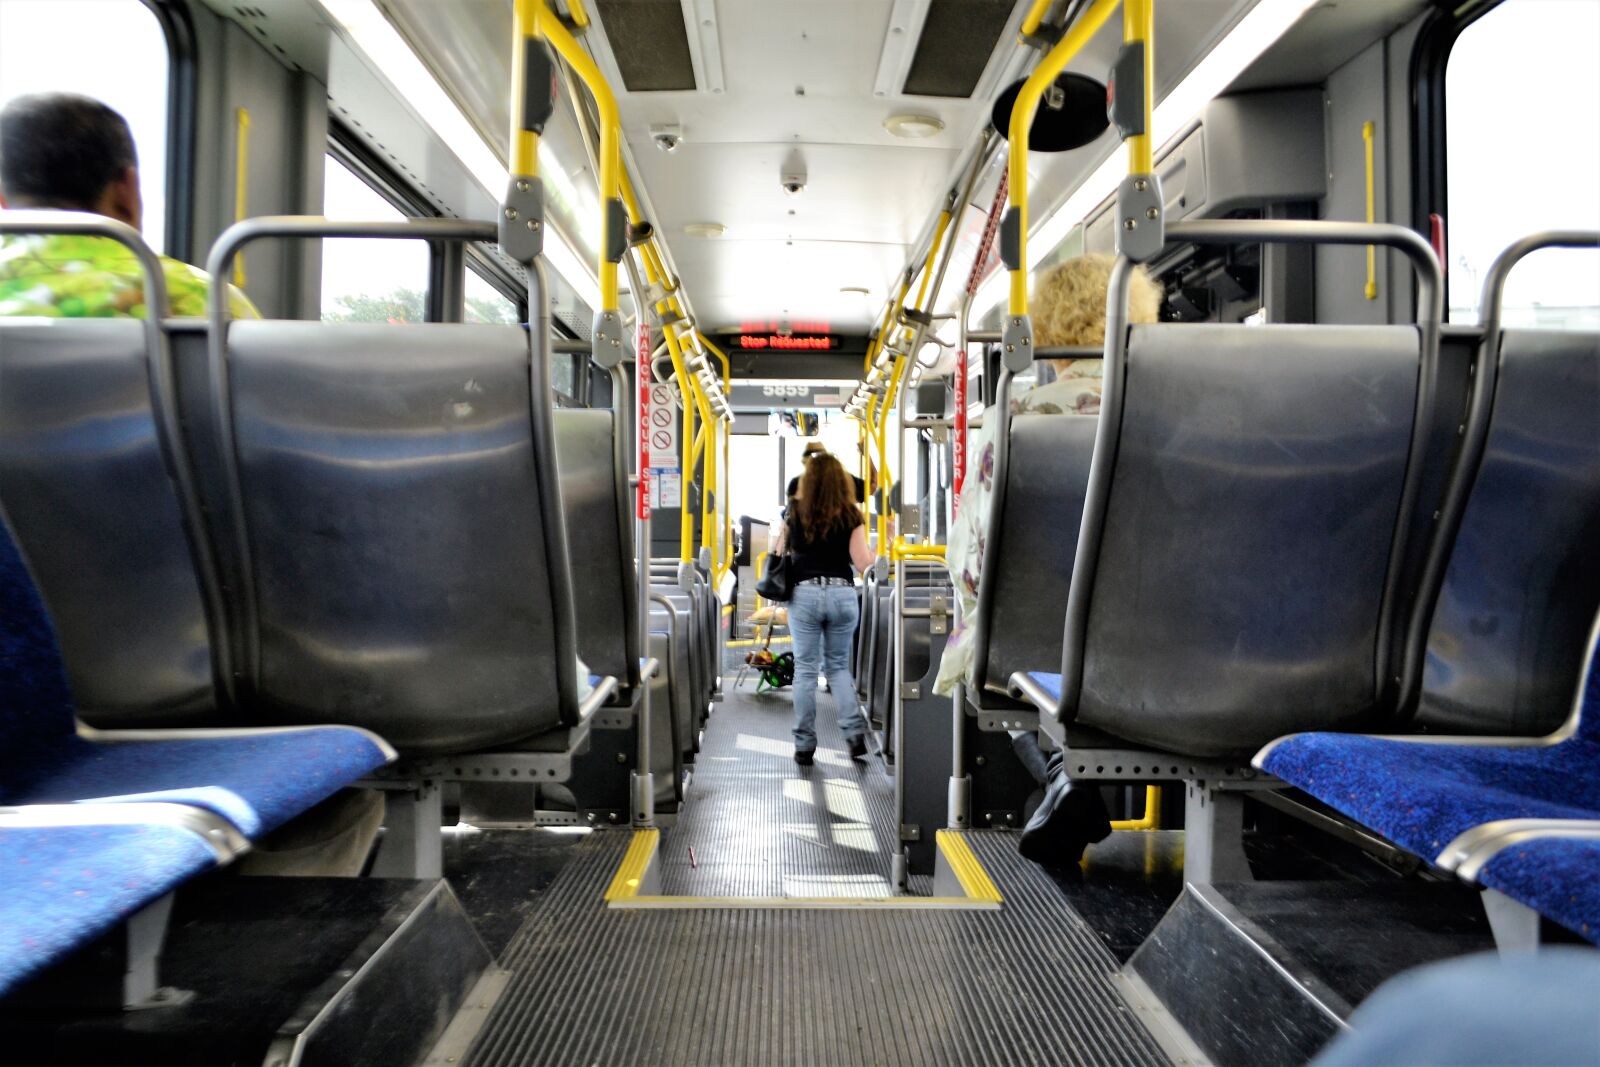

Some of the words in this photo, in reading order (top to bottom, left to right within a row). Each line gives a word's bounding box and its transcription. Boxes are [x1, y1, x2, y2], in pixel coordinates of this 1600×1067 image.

[640, 325, 650, 388] WATCH
[763, 385, 809, 397] 5859
[641, 403, 649, 453] YOUR
[954, 429, 963, 479] YOUR
[642, 467, 650, 518] STEP
